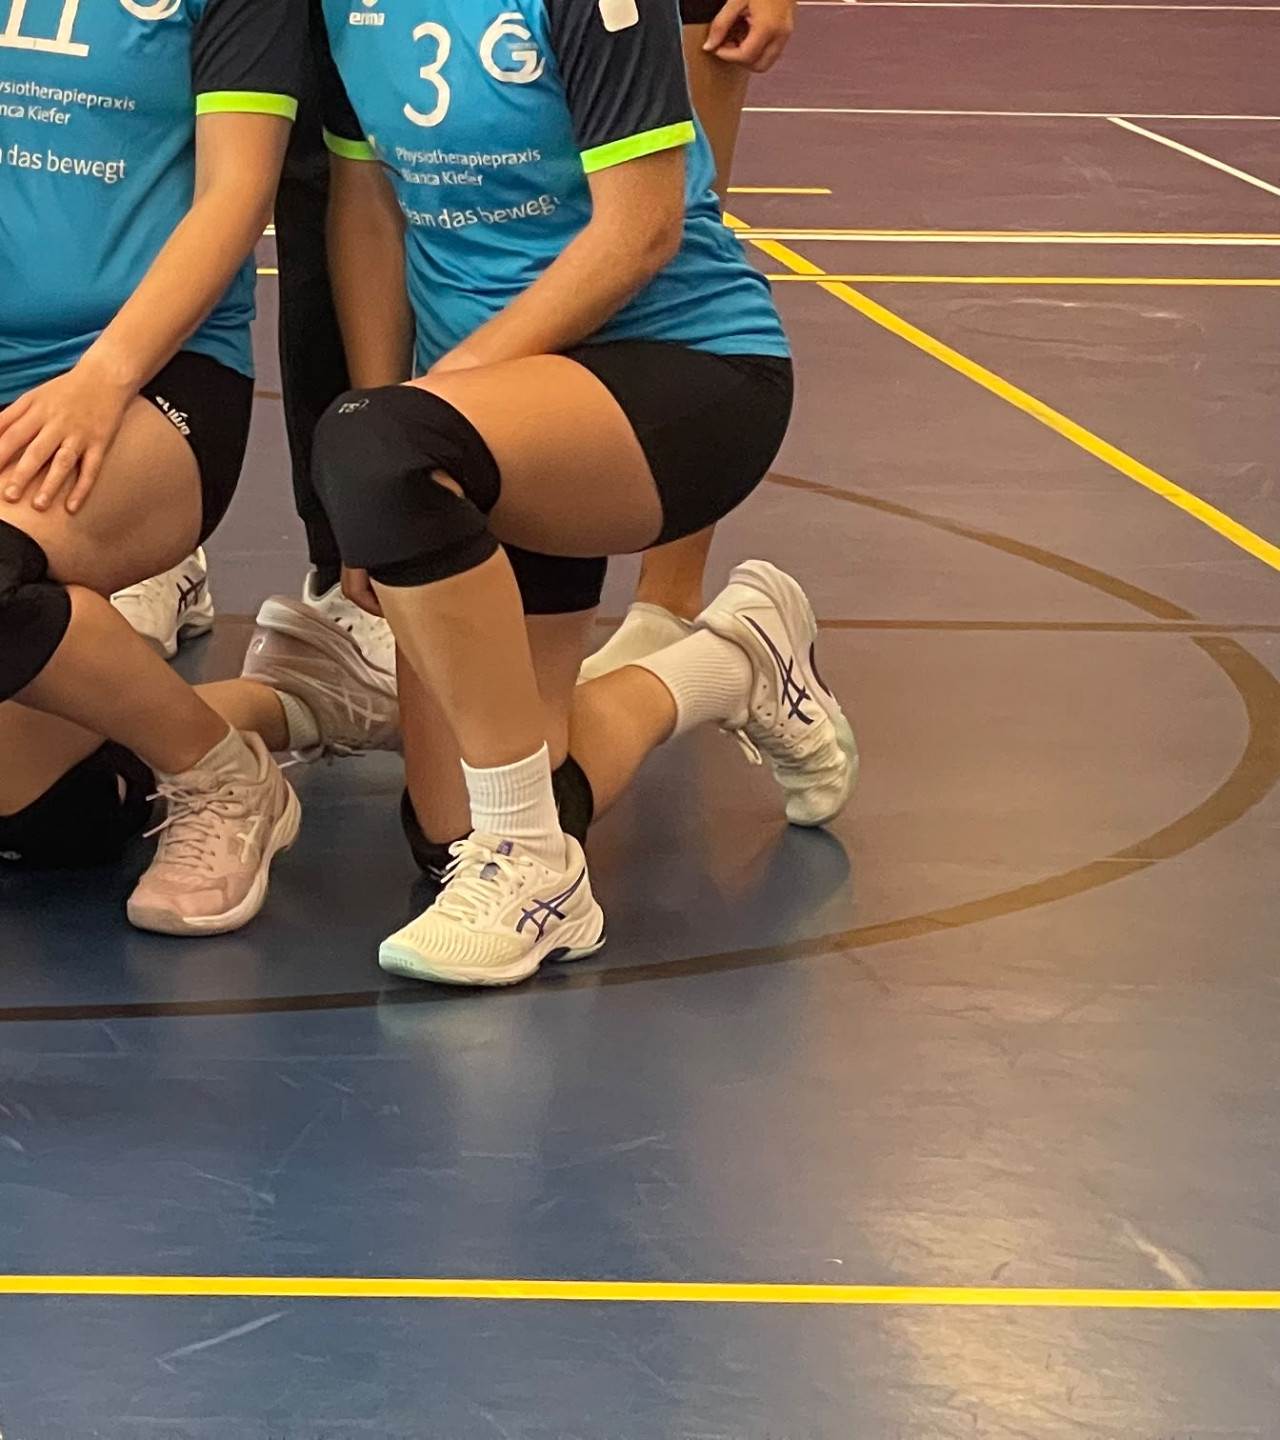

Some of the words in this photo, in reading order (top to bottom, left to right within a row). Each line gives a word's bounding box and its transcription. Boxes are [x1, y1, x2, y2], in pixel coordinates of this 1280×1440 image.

[403, 21, 451, 127] 3
[27, 104, 71, 126] Kiefer
[7, 144, 43, 170] das
[47, 150, 126, 184] bewegt
[439, 207, 478, 230] das
